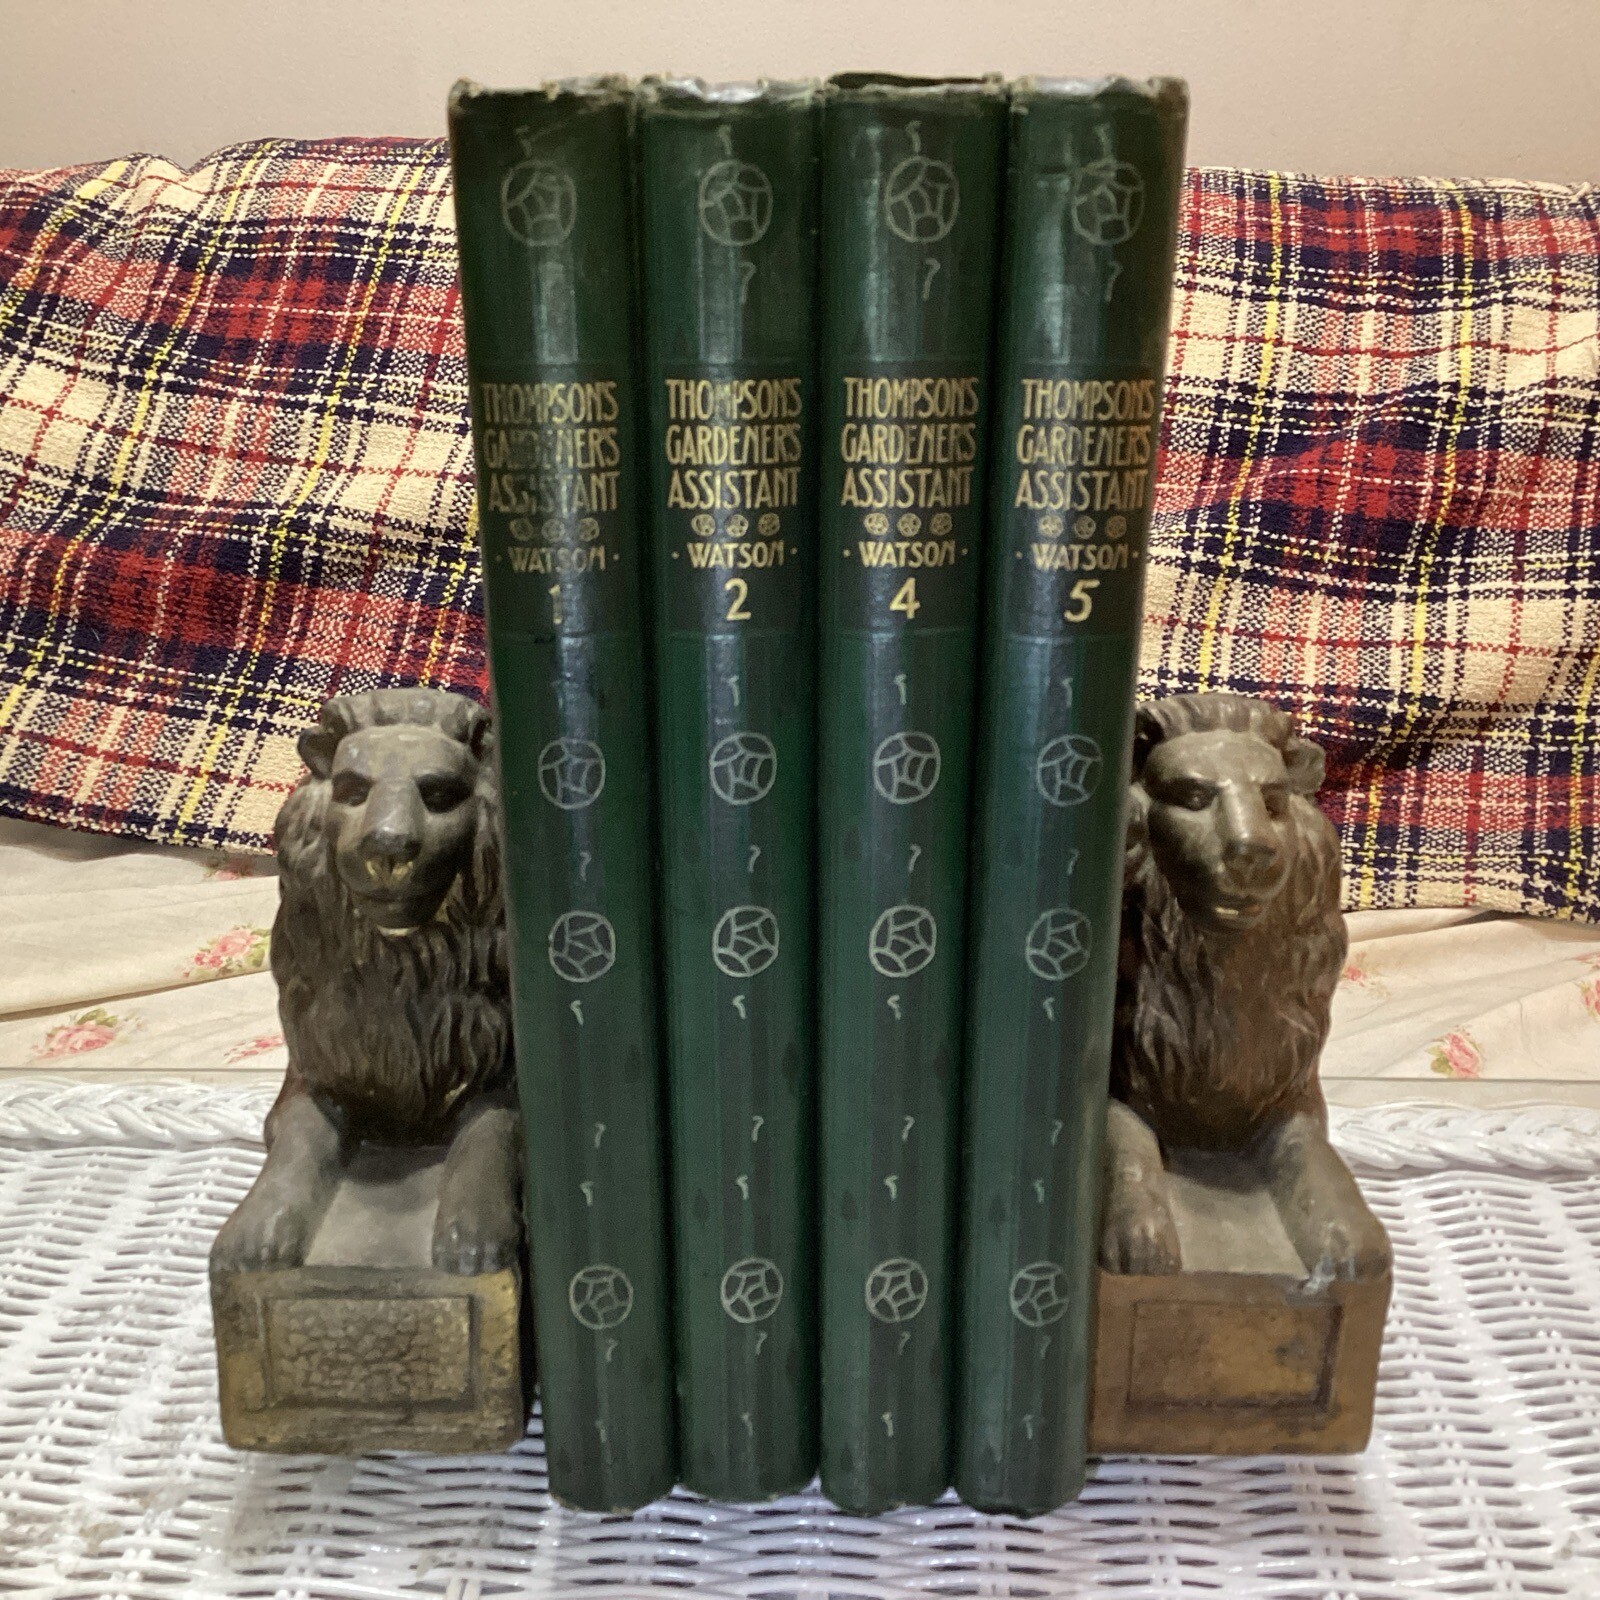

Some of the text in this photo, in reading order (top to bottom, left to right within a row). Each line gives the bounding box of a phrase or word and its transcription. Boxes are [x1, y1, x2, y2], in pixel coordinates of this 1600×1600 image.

[665, 378, 802, 420] THOMPSONS
[843, 377, 979, 419] THOMPSONS
[1021, 378, 1155, 420] THOMPSONS
[665, 424, 802, 466] GARDENERS
[841, 424, 977, 464] GARDENERS
[1016, 424, 1151, 467] GARDENERS
[667, 467, 800, 510] ASSISTANT
[841, 466, 975, 508] ASSISTANT
[1015, 469, 1148, 510] ASSISTANT
[508, 546, 606, 575] WATSON
[687, 541, 784, 569] WATSON
[858, 541, 956, 568] WATSON
[1032, 543, 1128, 571] WATSON
[724, 577, 751, 621] 2
[889, 577, 921, 620] 4
[1063, 578, 1101, 623] 5
